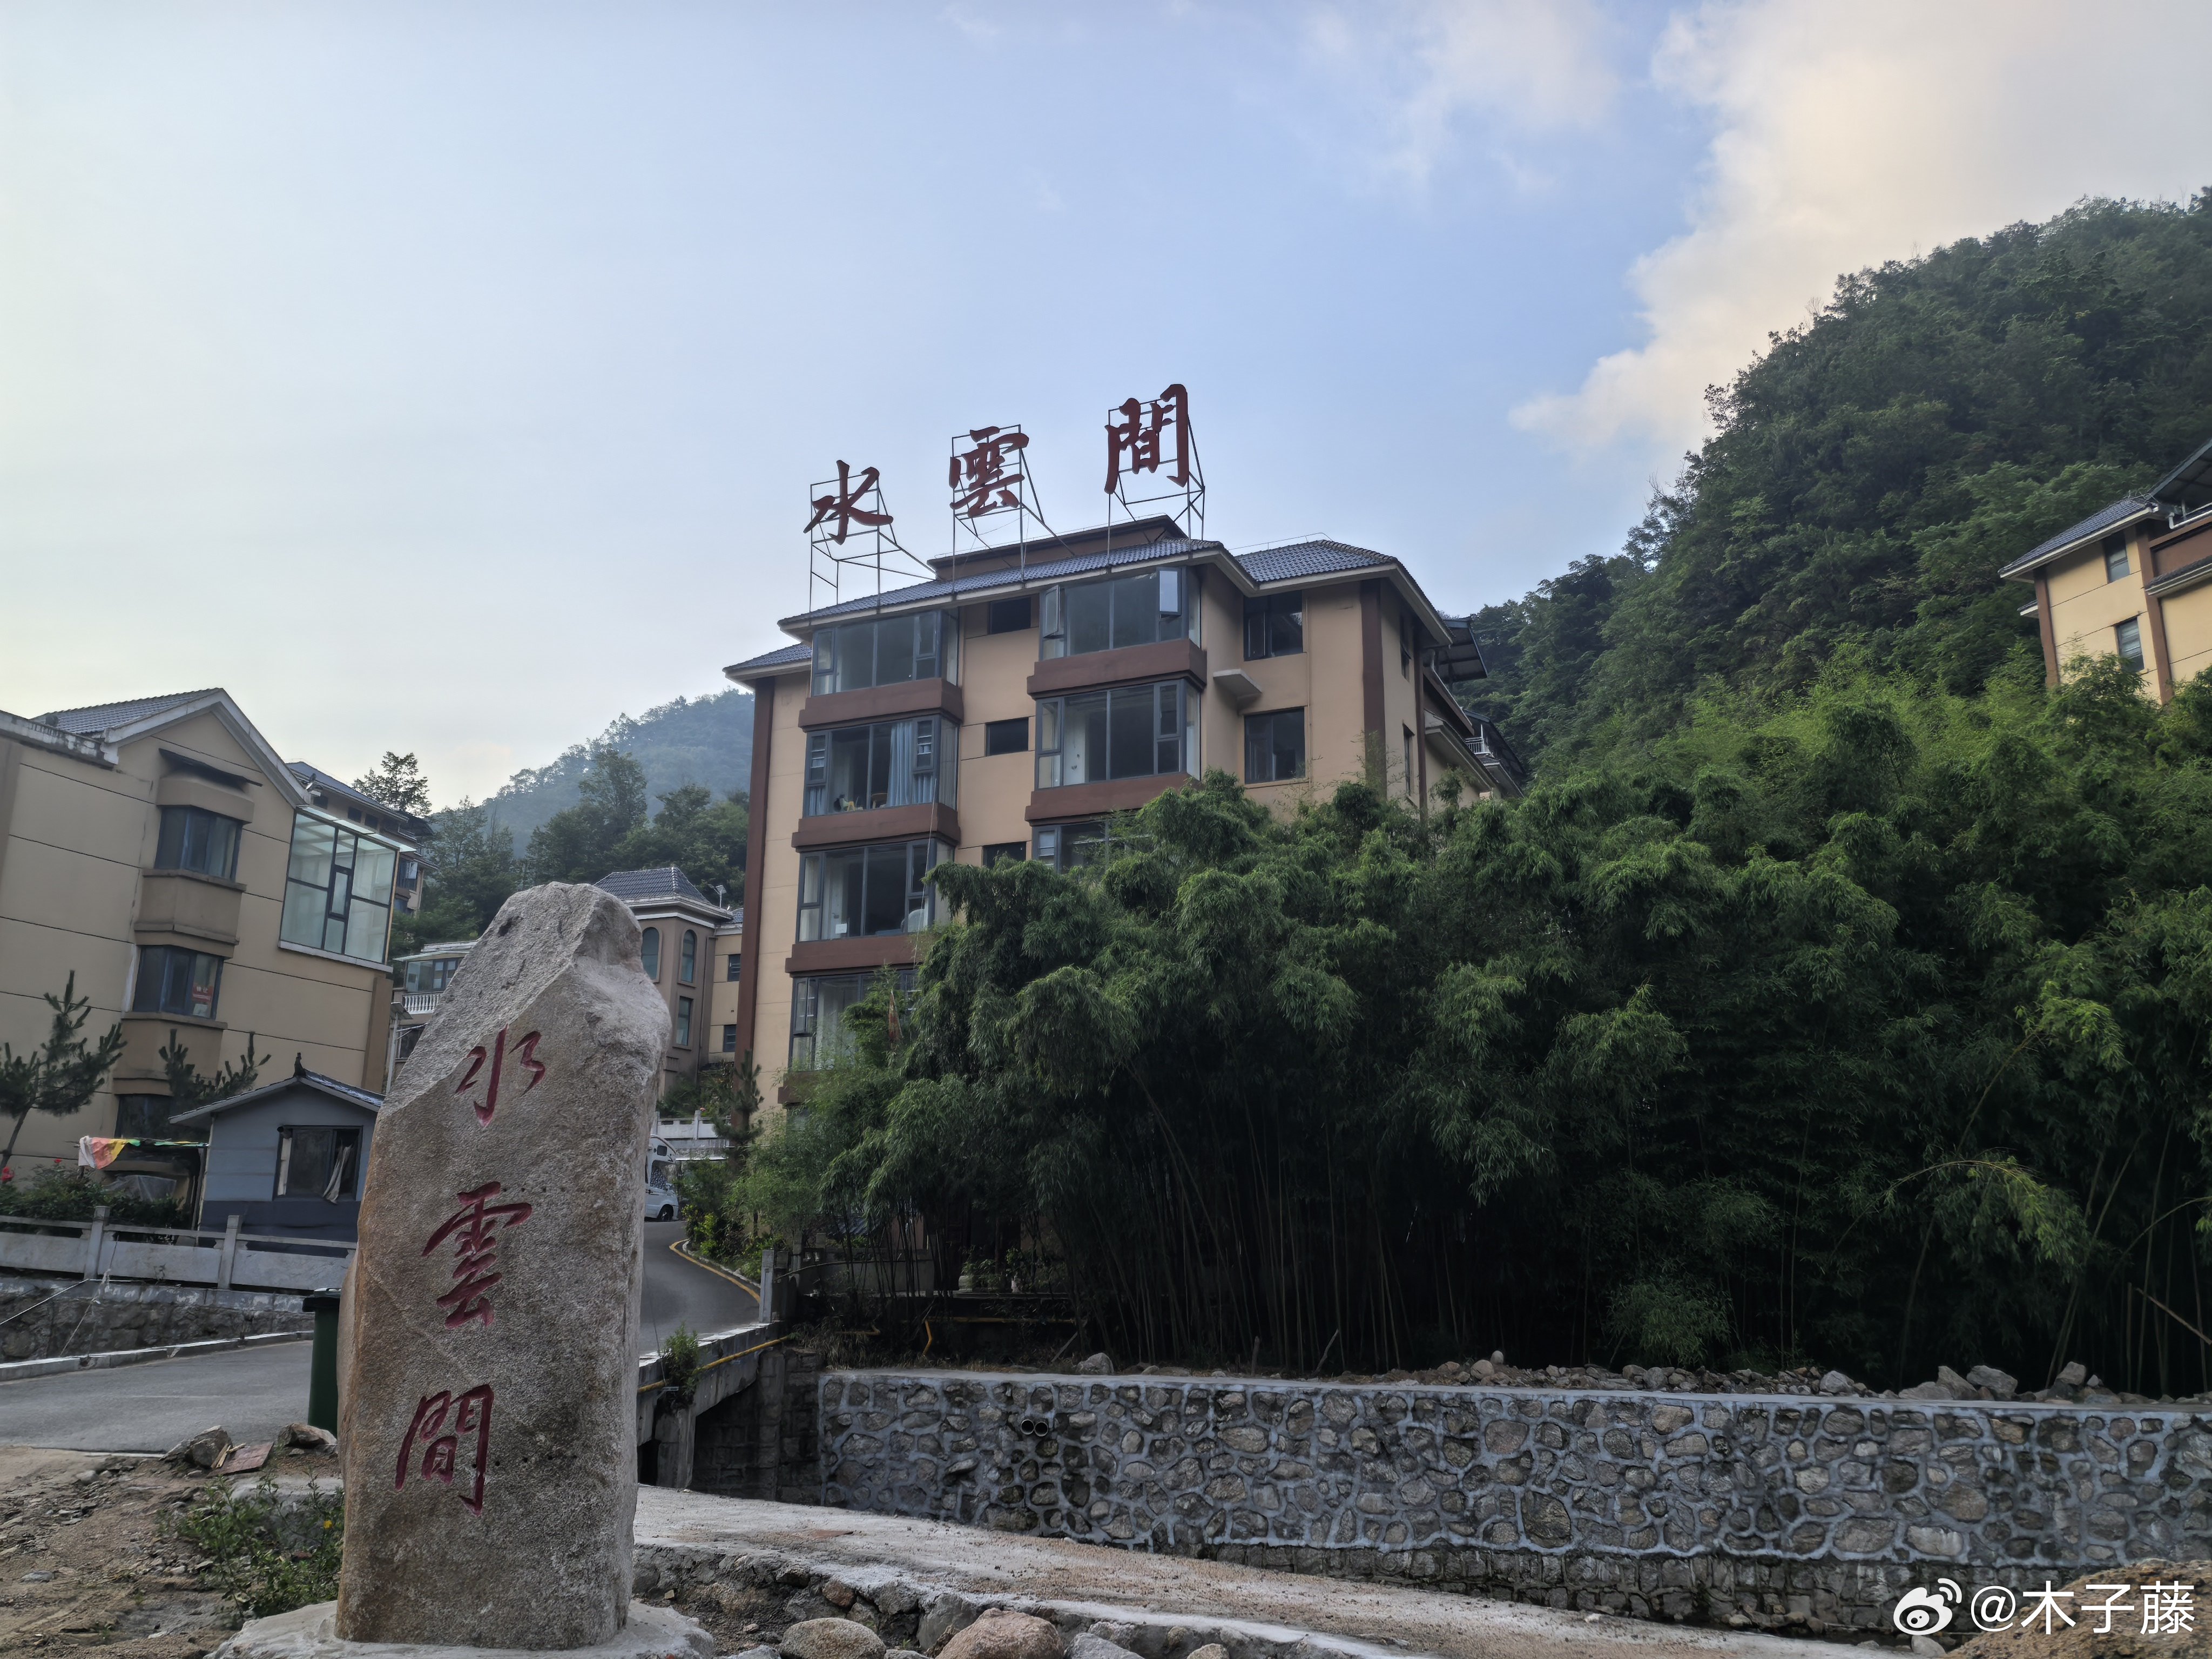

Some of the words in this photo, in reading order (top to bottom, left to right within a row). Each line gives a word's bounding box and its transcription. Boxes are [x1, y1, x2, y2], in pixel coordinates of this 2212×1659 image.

[804, 384, 1189, 545] 水雲間
[395, 1023, 546, 1516] 水雲間
